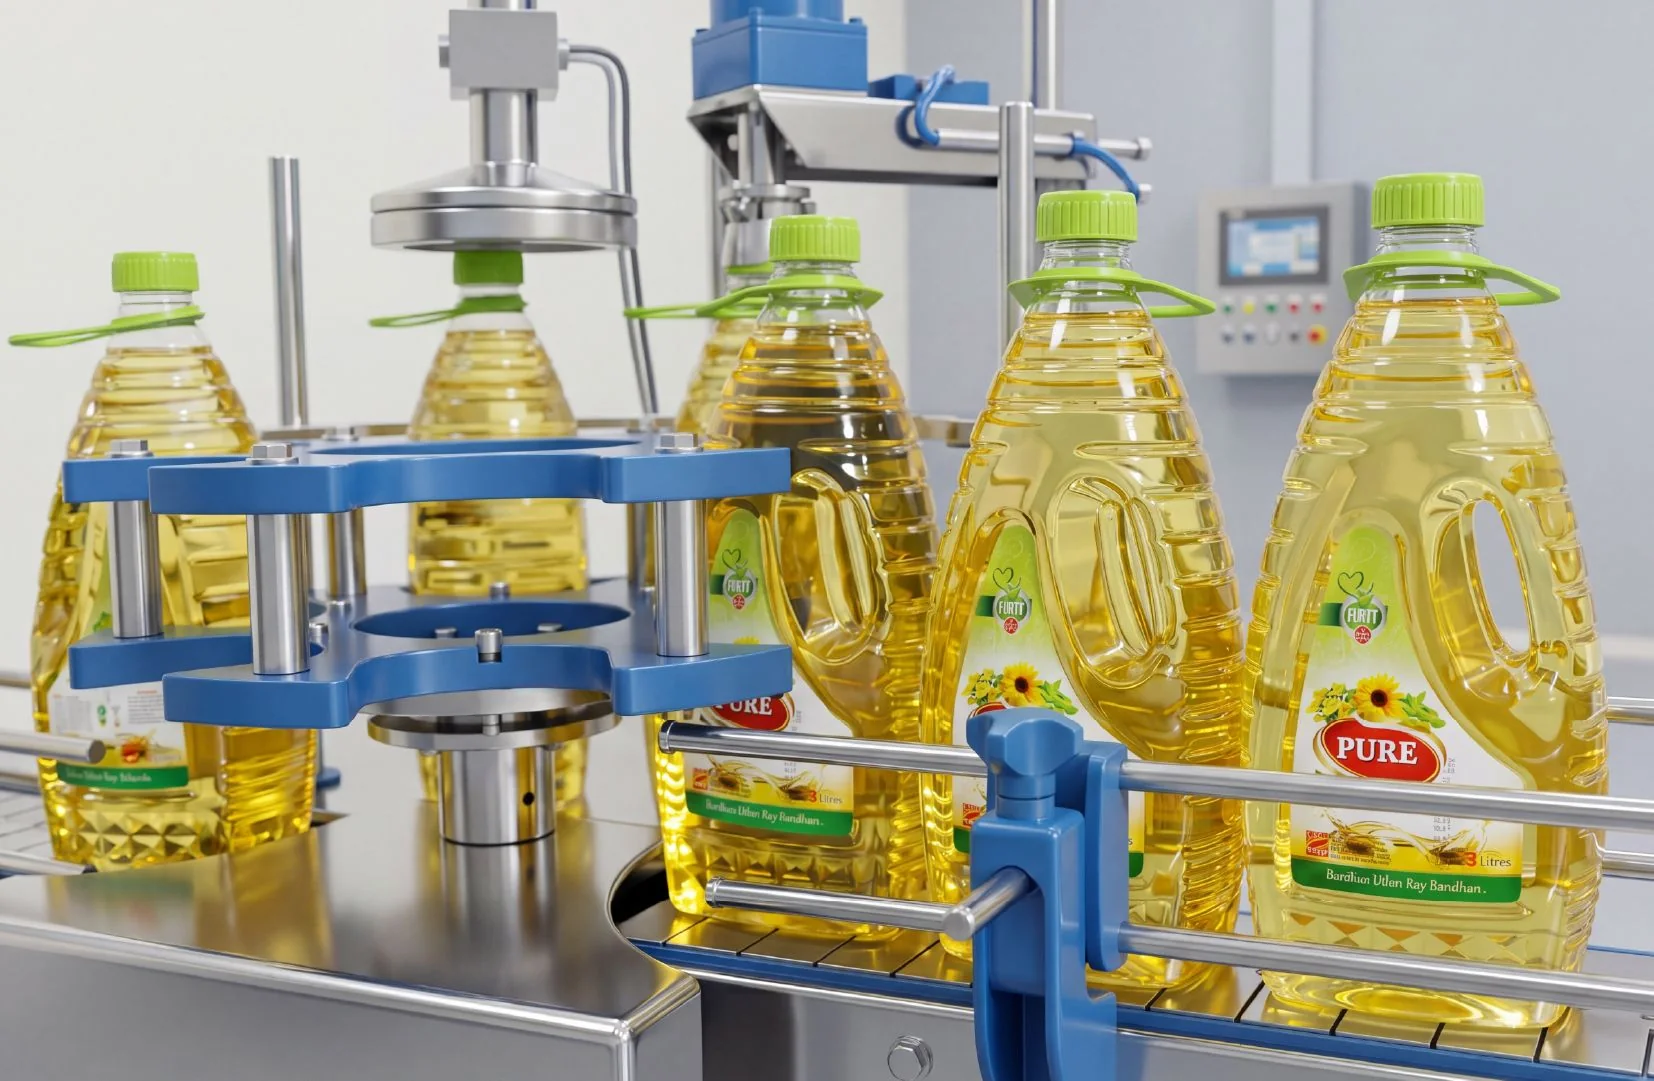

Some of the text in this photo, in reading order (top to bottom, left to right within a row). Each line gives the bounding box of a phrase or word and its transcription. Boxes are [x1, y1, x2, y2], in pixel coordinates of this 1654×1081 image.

[714, 696, 773, 716] URE
[1336, 736, 1418, 765] PURE
[808, 790, 817, 803] 3
[1464, 851, 1512, 867] 3 Litres
[1406, 878, 1427, 893] Ray
